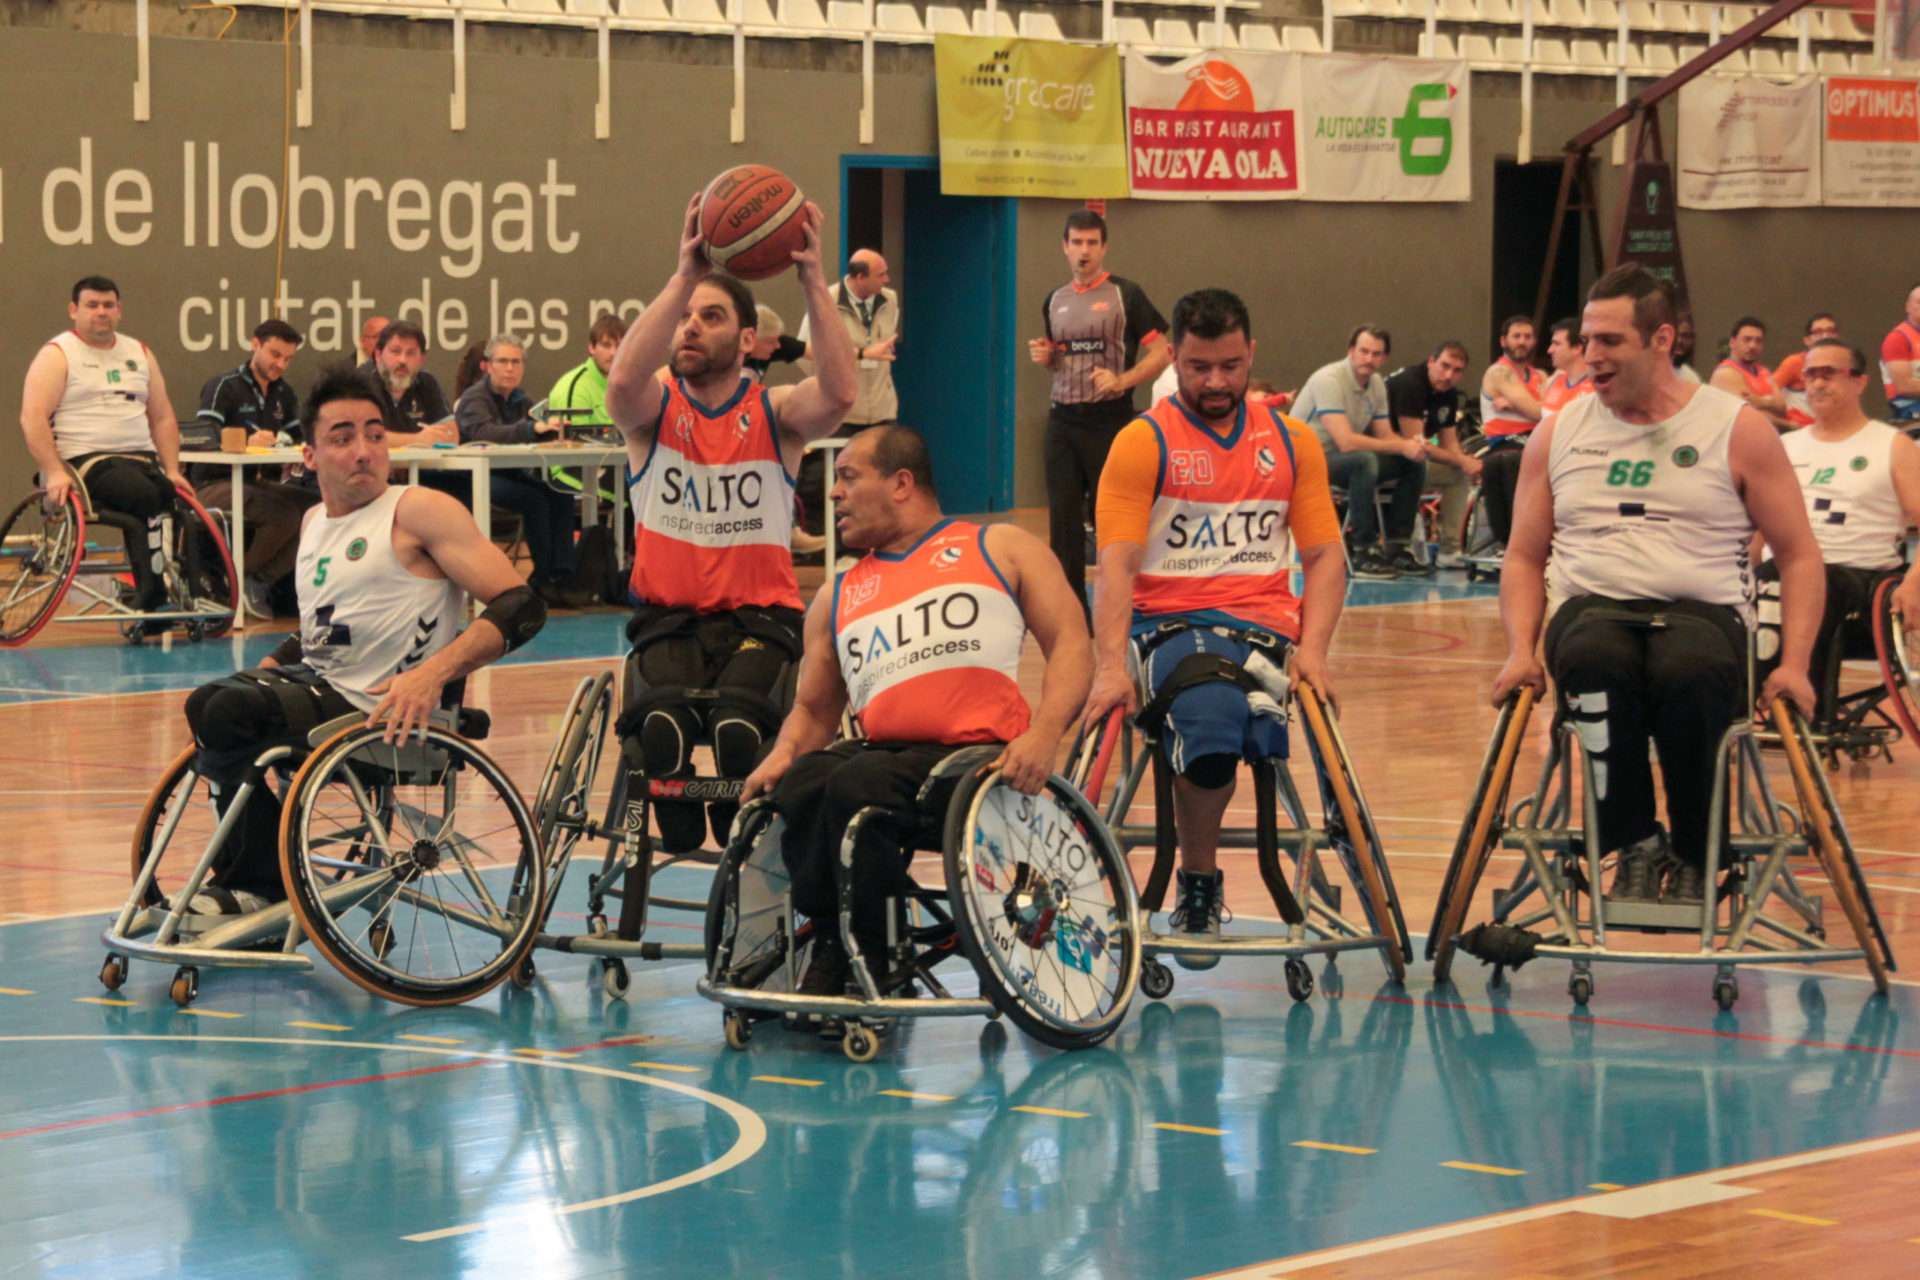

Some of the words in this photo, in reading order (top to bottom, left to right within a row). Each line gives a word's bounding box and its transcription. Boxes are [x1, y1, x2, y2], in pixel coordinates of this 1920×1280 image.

[1828, 88, 1915, 118] OPTIMUS
[1133, 118, 1167, 137] BAR
[1315, 116, 1387, 138] AUTOCARS
[1134, 148, 1232, 179] NUEVA
[1235, 150, 1288, 179] OLA
[42, 136, 153, 246] de
[183, 140, 580, 278] llobregat
[728, 183, 783, 229] molten
[179, 279, 375, 352] ciutat
[399, 278, 469, 350] de
[490, 278, 568, 350] les
[107, 369, 120, 384] 16
[1170, 450, 1213, 485] 20
[1607, 460, 1655, 487] 66
[1809, 467, 1836, 485] 12
[661, 467, 762, 512] SALTO
[661, 515, 763, 535] nspredaccess
[312, 556, 332, 587] 5
[848, 592, 980, 674] SALTO
[1015, 796, 1087, 872] SALTO
